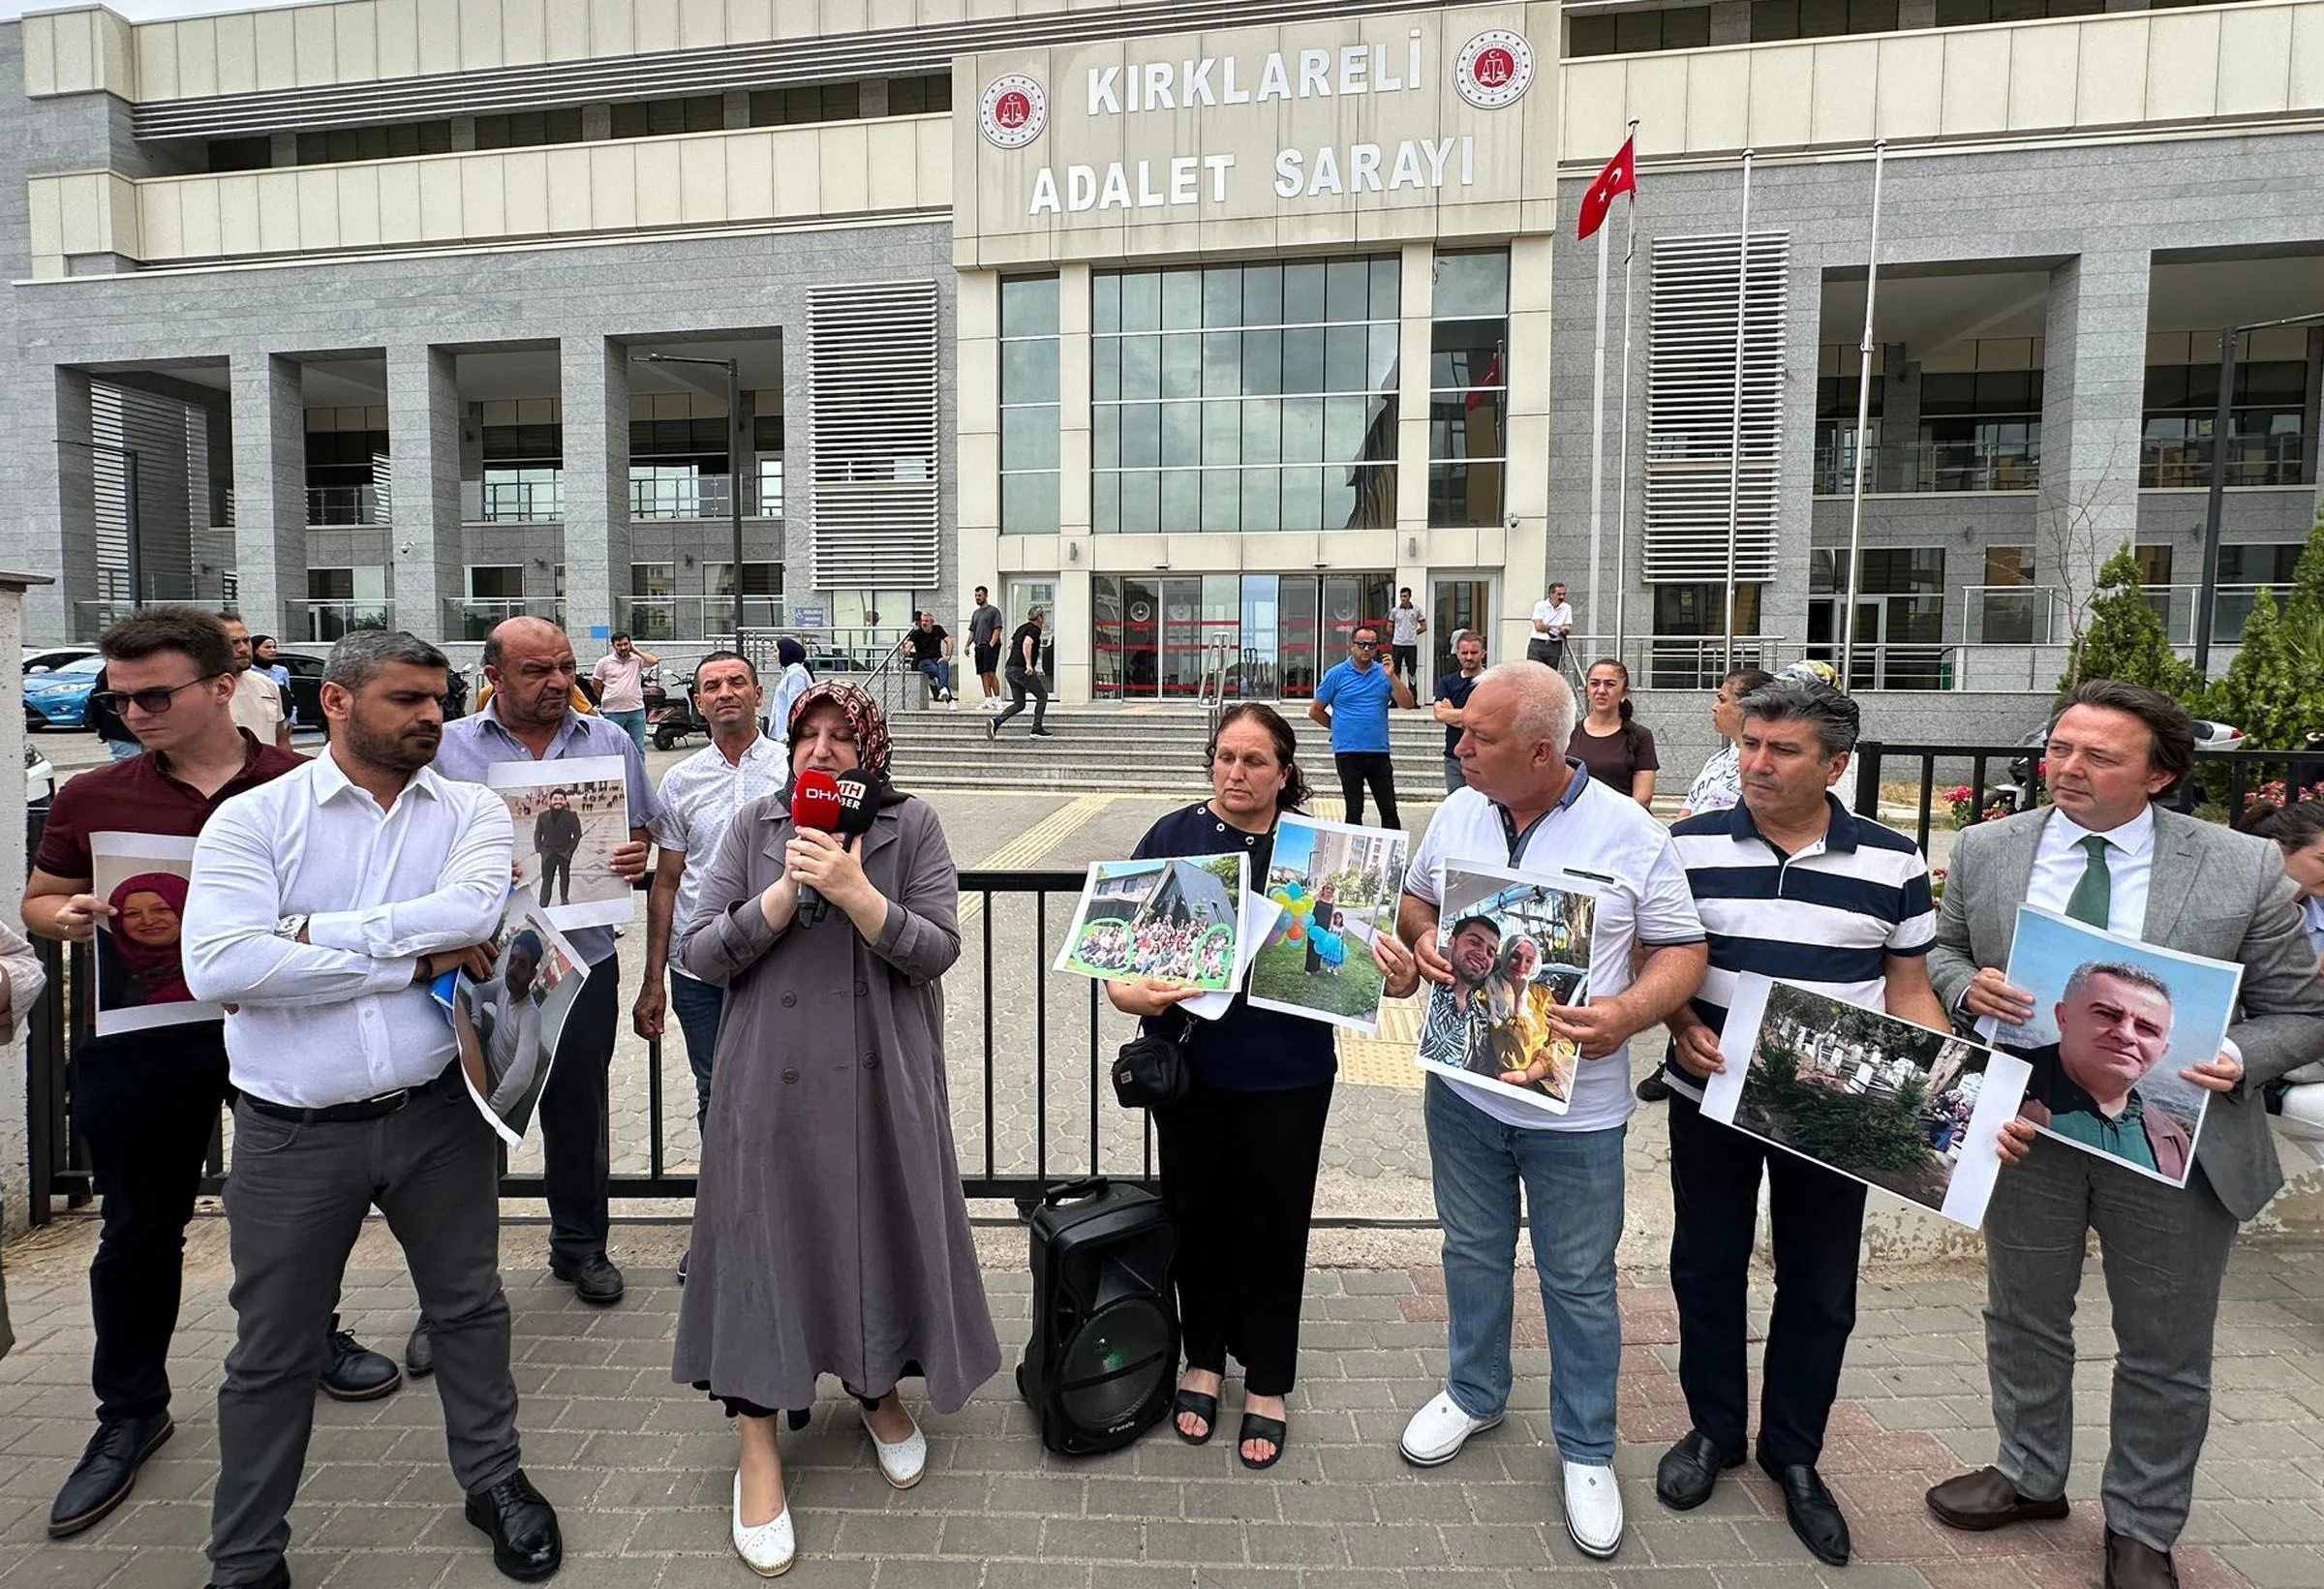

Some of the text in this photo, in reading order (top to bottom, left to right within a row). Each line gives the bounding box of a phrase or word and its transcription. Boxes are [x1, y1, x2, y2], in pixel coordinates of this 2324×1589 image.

[1087, 28, 1421, 116] KIRKLARELİ
[1028, 136, 1473, 215] ADALET SARAYI
[806, 787, 841, 803] DHA
